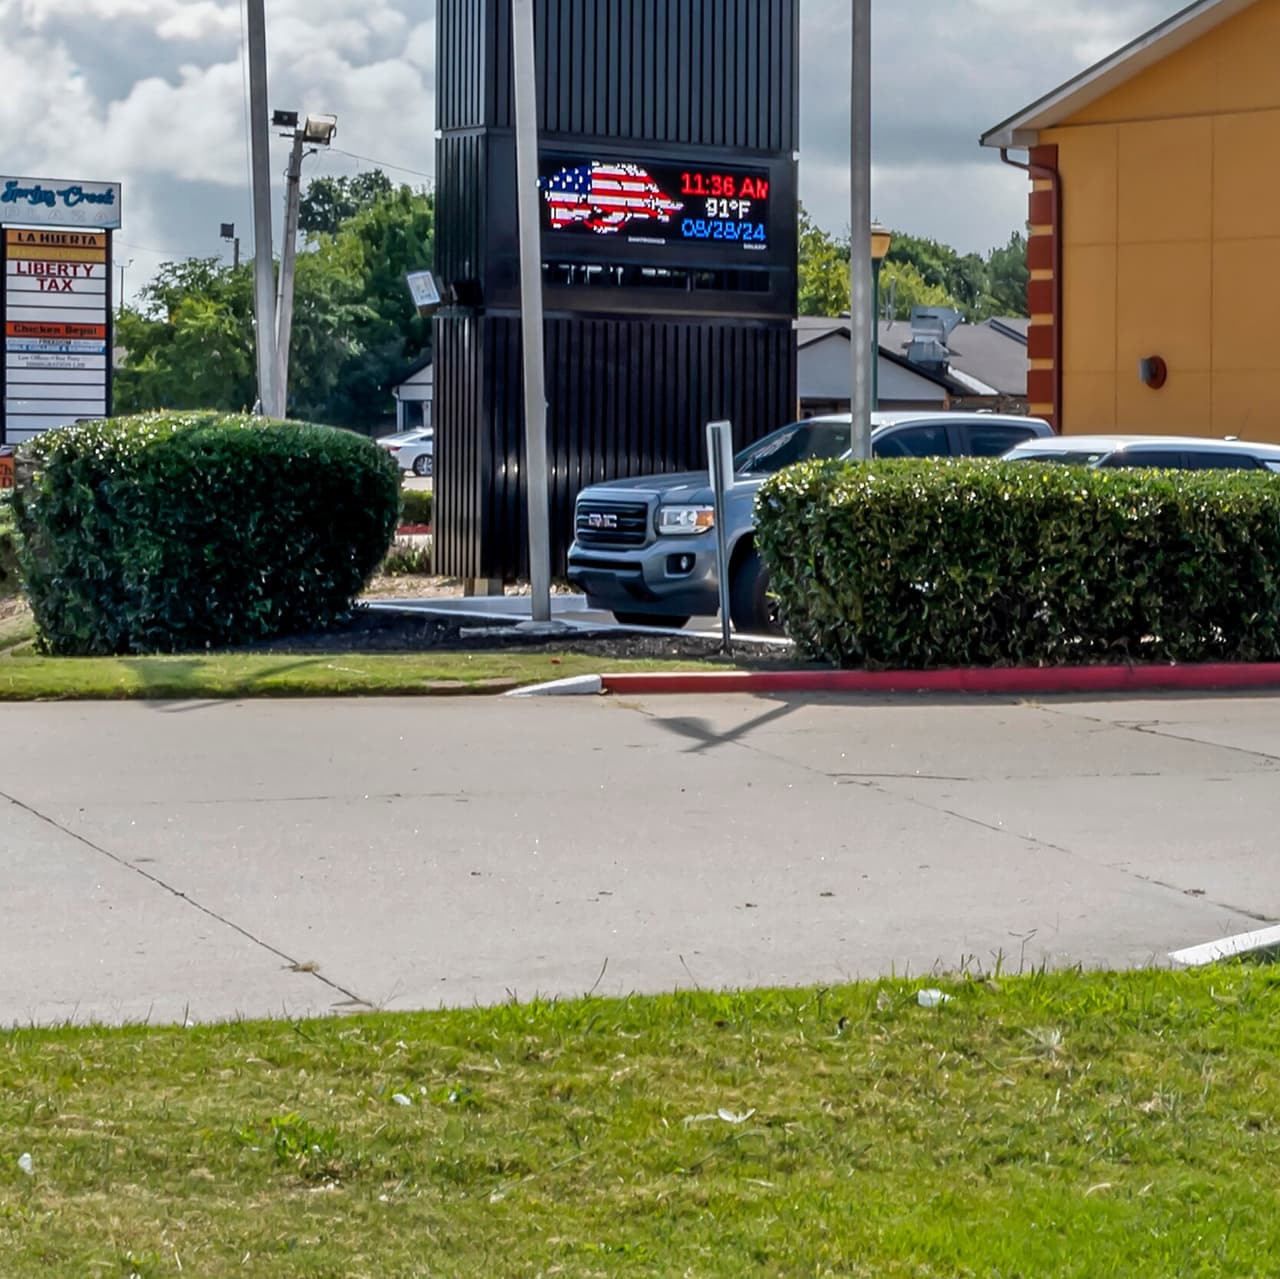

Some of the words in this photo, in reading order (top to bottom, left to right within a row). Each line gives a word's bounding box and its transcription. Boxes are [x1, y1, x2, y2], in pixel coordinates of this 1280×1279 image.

[681, 173, 735, 196] 11:36
[681, 218, 766, 241] 08/28/24
[17, 232, 36, 242] LA
[40, 233, 97, 245] HUERTA
[16, 261, 94, 277] LIBERTY
[36, 278, 74, 292] TAX
